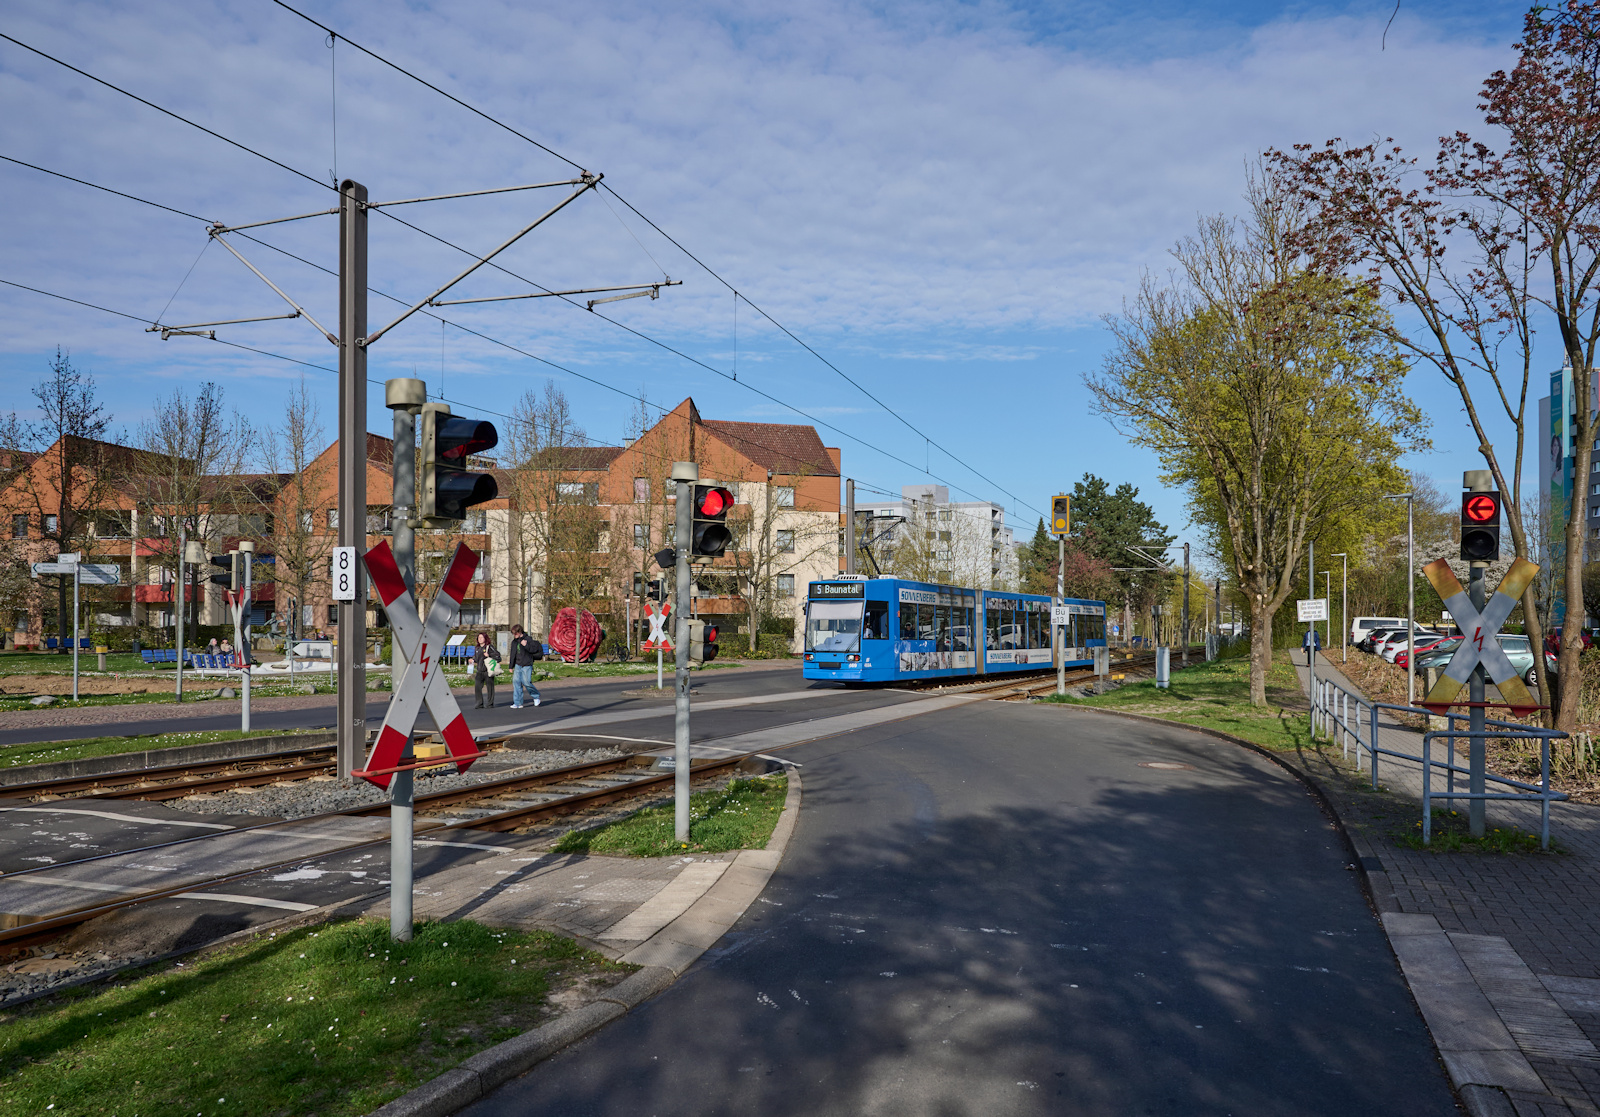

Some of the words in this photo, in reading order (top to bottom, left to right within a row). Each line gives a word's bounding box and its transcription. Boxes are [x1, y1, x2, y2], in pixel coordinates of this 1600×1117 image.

[340, 551, 348, 570] 8
[340, 574, 348, 592] 8
[816, 584, 822, 594] 5
[824, 584, 858, 594] Baunatal
[900, 590, 936, 603] SONNENBERG
